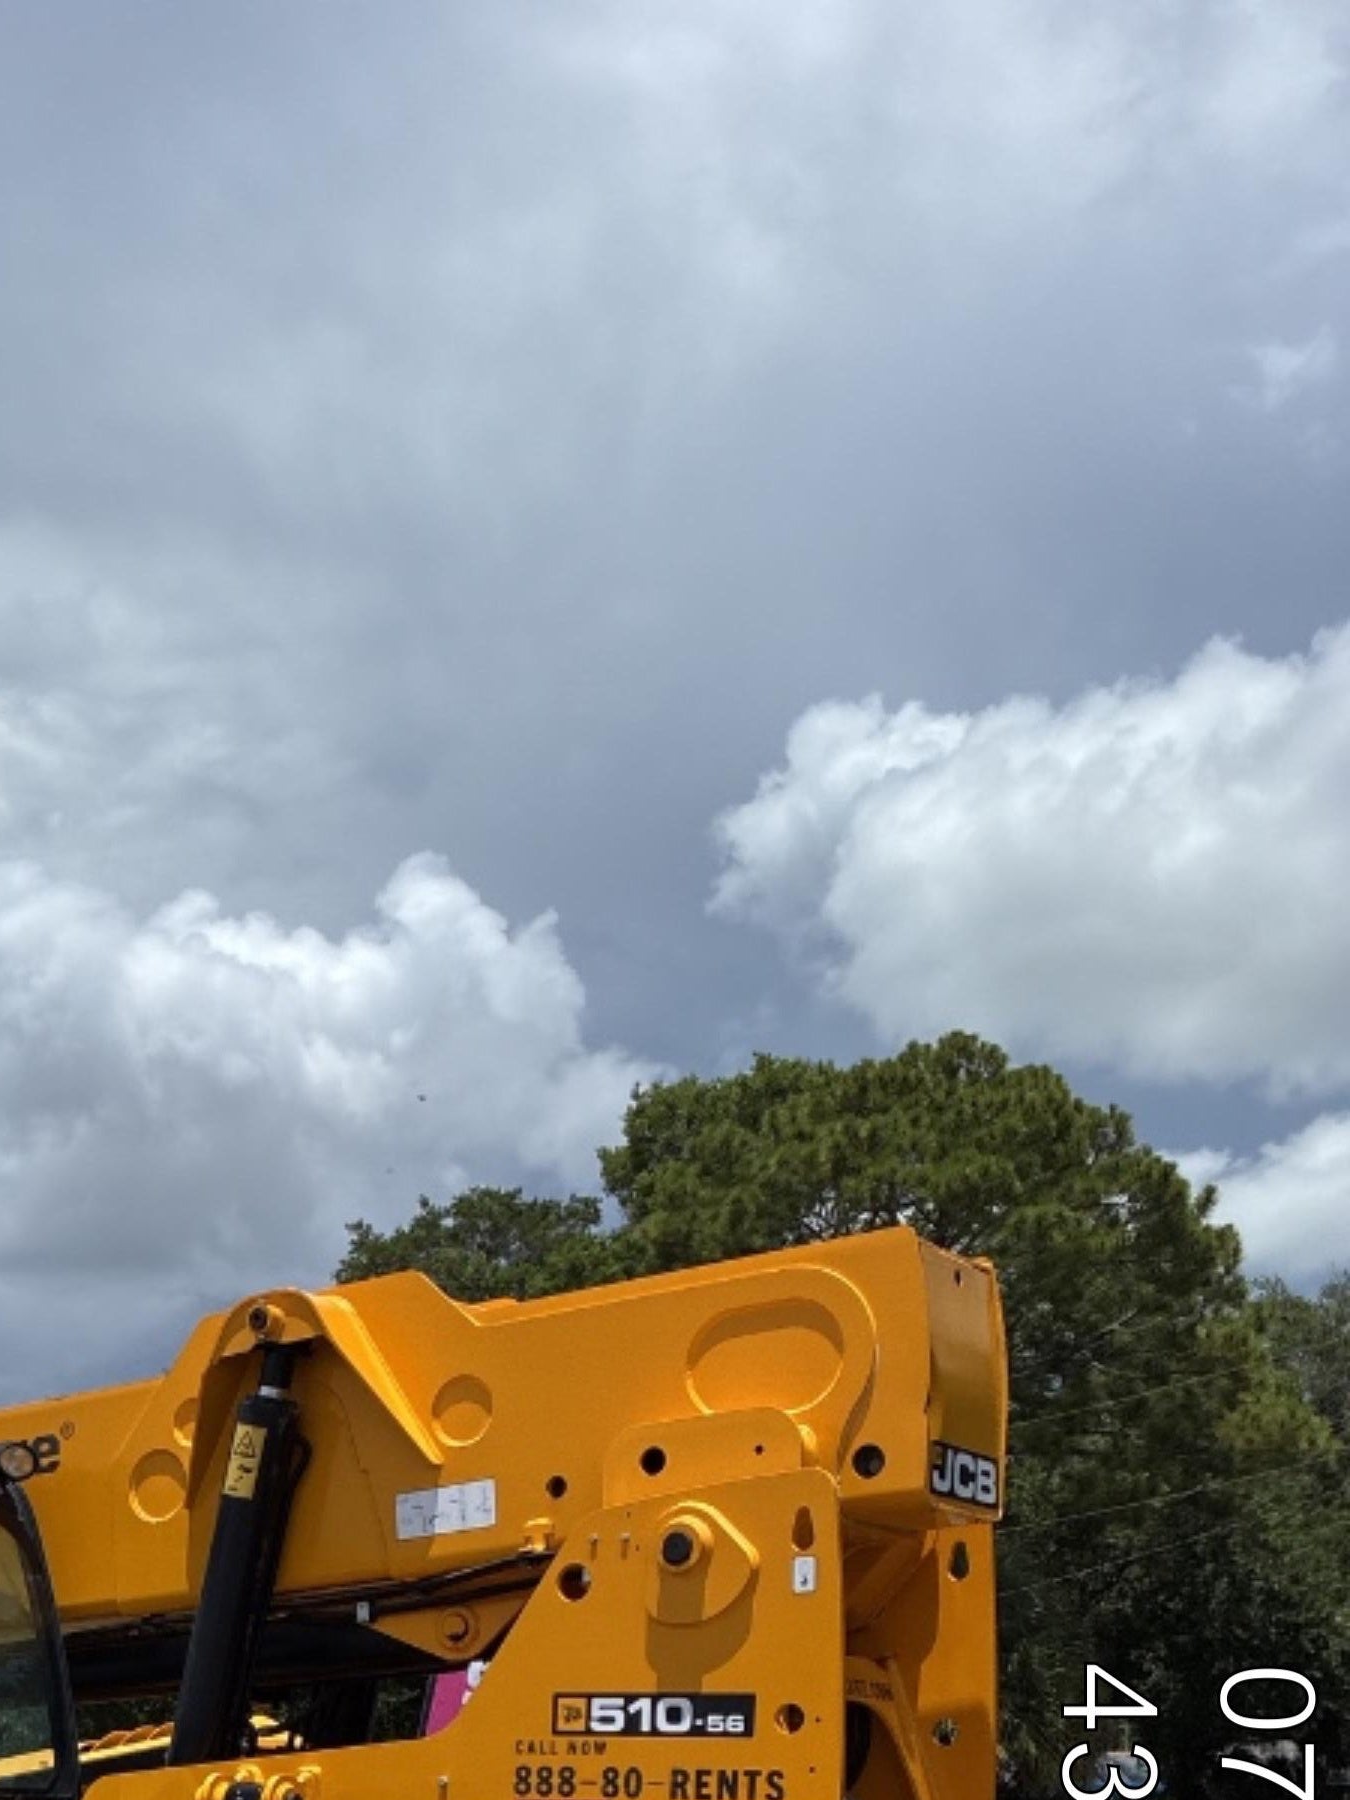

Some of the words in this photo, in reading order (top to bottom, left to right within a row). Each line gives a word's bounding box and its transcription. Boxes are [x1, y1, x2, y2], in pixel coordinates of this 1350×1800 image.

[932, 1448, 997, 1504] JCB
[514, 1739, 559, 1755] CALL
[566, 1740, 608, 1756] NOW
